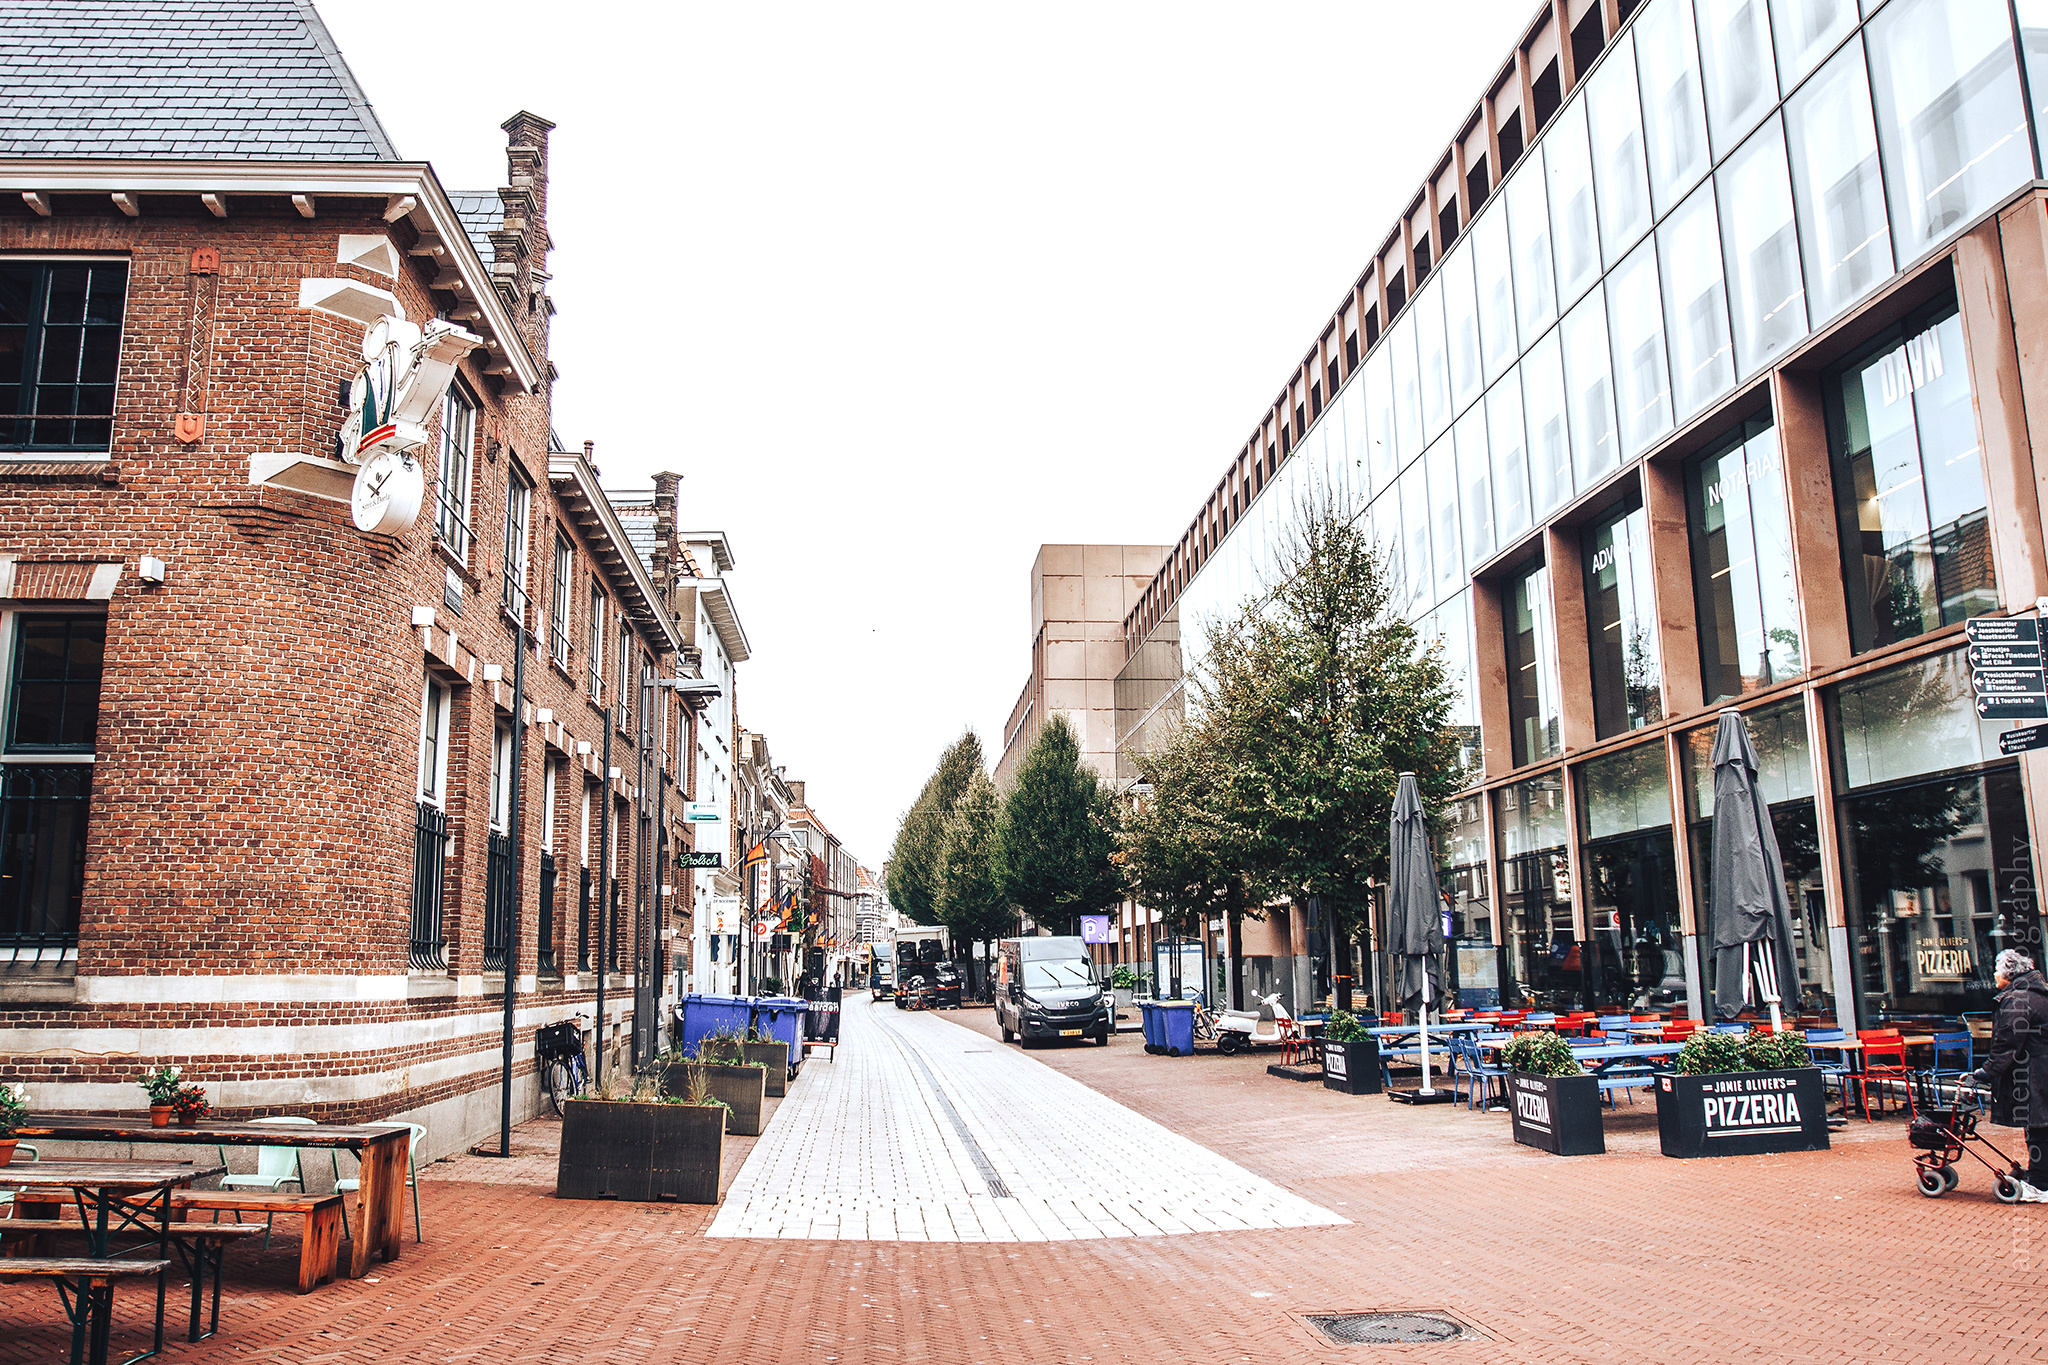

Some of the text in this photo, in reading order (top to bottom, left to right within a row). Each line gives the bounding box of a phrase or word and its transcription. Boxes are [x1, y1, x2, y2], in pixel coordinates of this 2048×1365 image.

[680, 853, 719, 867] Grolsch
[1085, 922, 1097, 942] P
[1916, 949, 1972, 974] PIZZERIA
[1057, 1000, 1079, 1008] IVECO
[1714, 1078, 1787, 1093] JAMIE OLIVER'S
[1516, 1090, 1551, 1125] PIZZERIA
[1703, 1093, 1802, 1128] PIZZERIA
